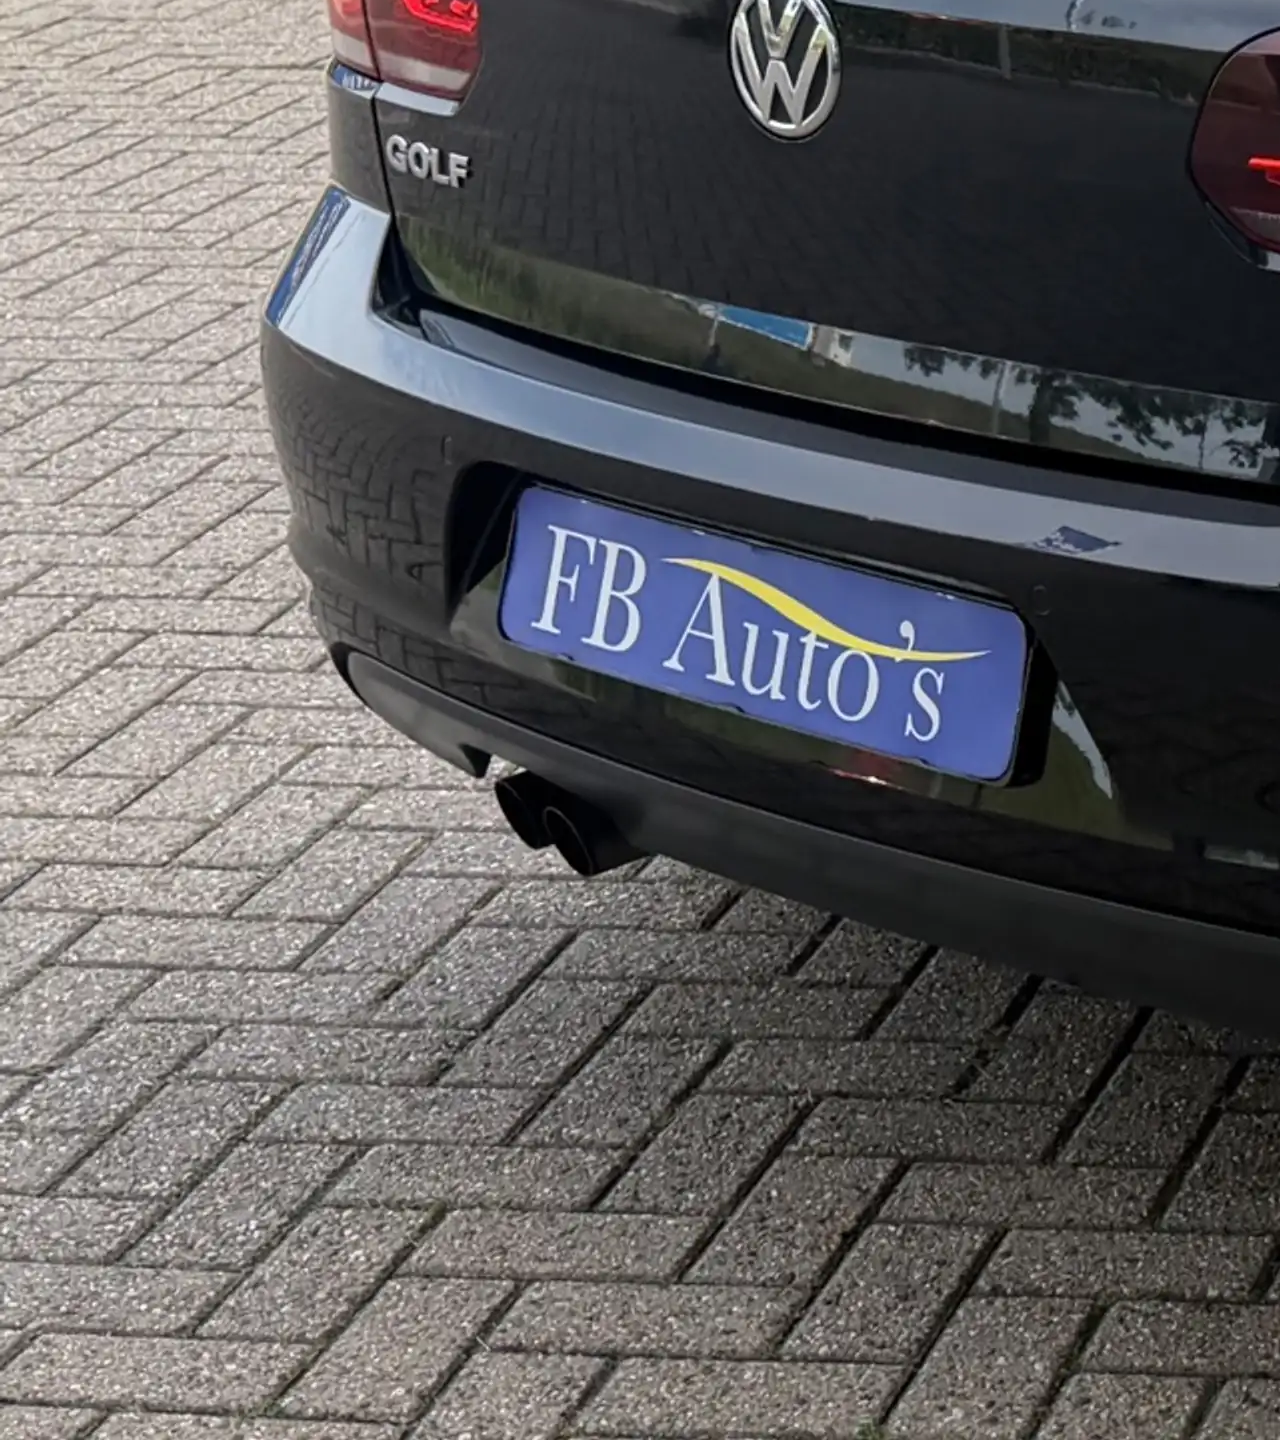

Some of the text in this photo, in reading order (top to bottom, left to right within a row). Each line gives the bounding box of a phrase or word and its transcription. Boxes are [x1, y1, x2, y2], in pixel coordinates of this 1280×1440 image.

[385, 134, 470, 189] GOLF
[531, 524, 945, 742] FB Auto's
